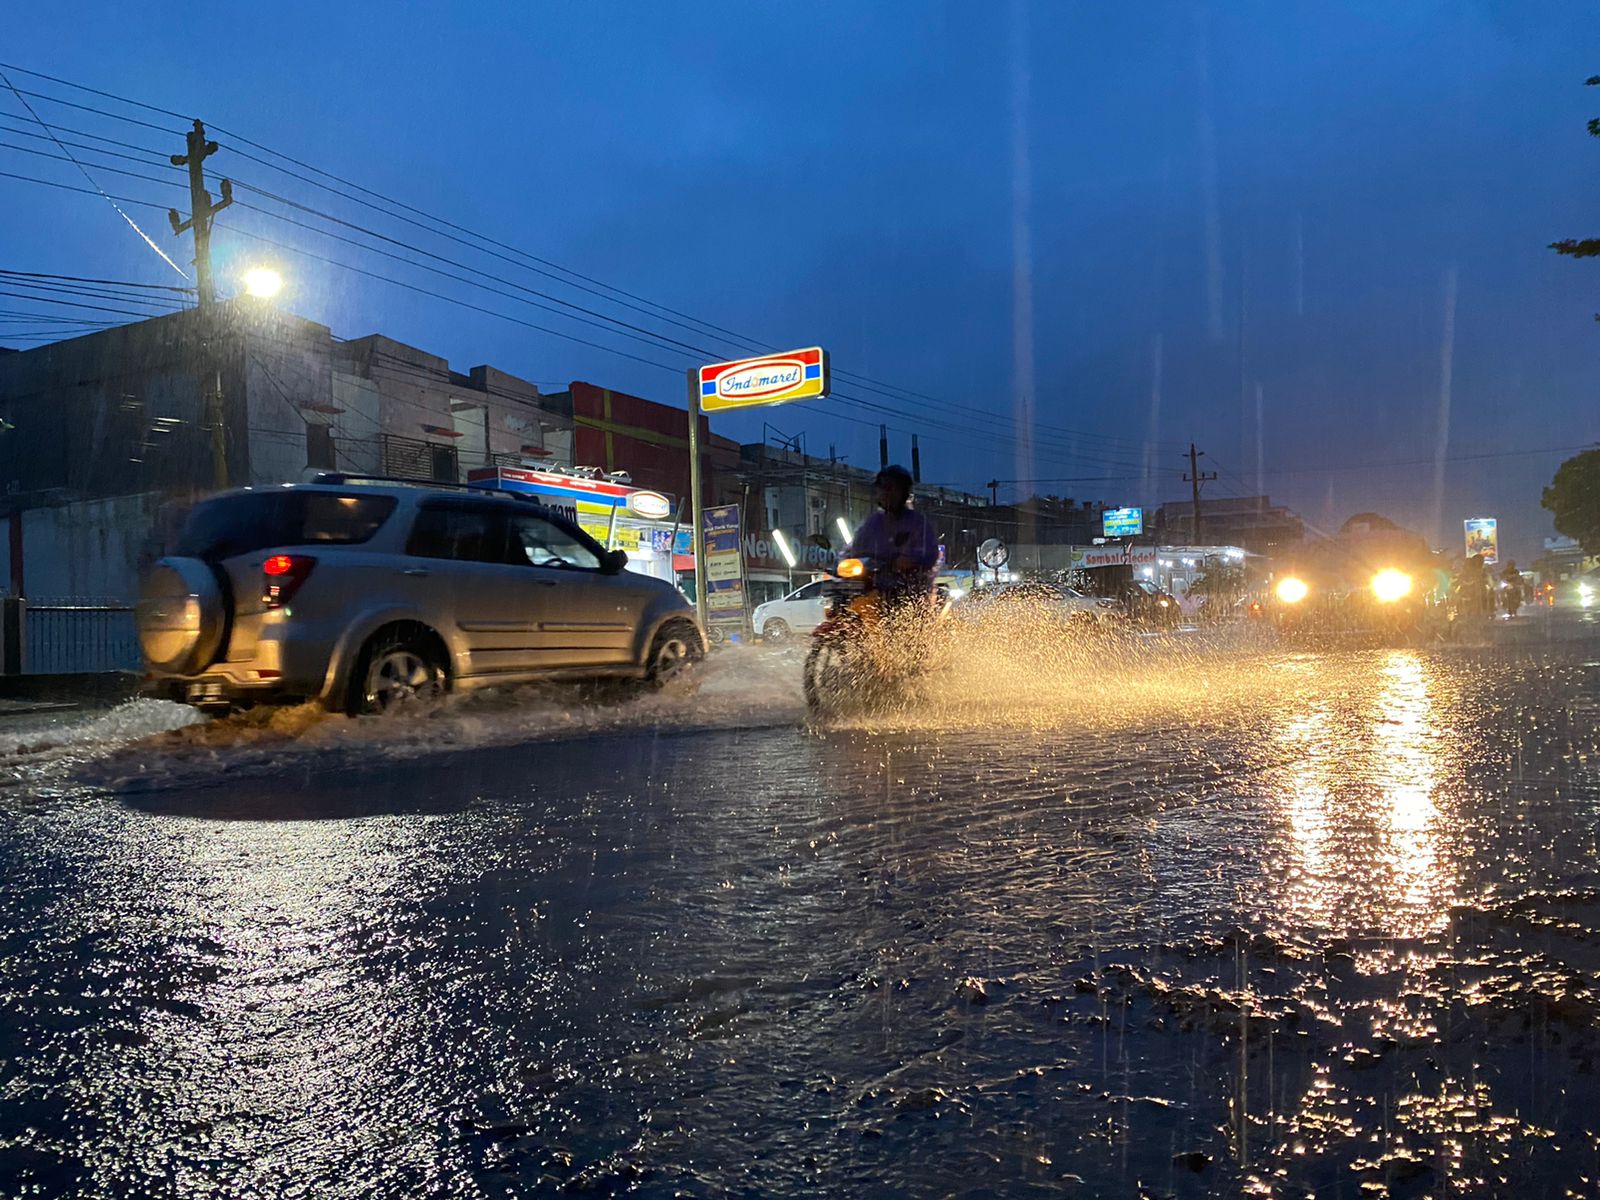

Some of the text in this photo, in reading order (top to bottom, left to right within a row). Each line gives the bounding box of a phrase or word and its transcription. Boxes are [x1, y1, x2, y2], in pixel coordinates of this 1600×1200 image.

[723, 367, 798, 392] Indomaret
[745, 533, 836, 564] New Drago
